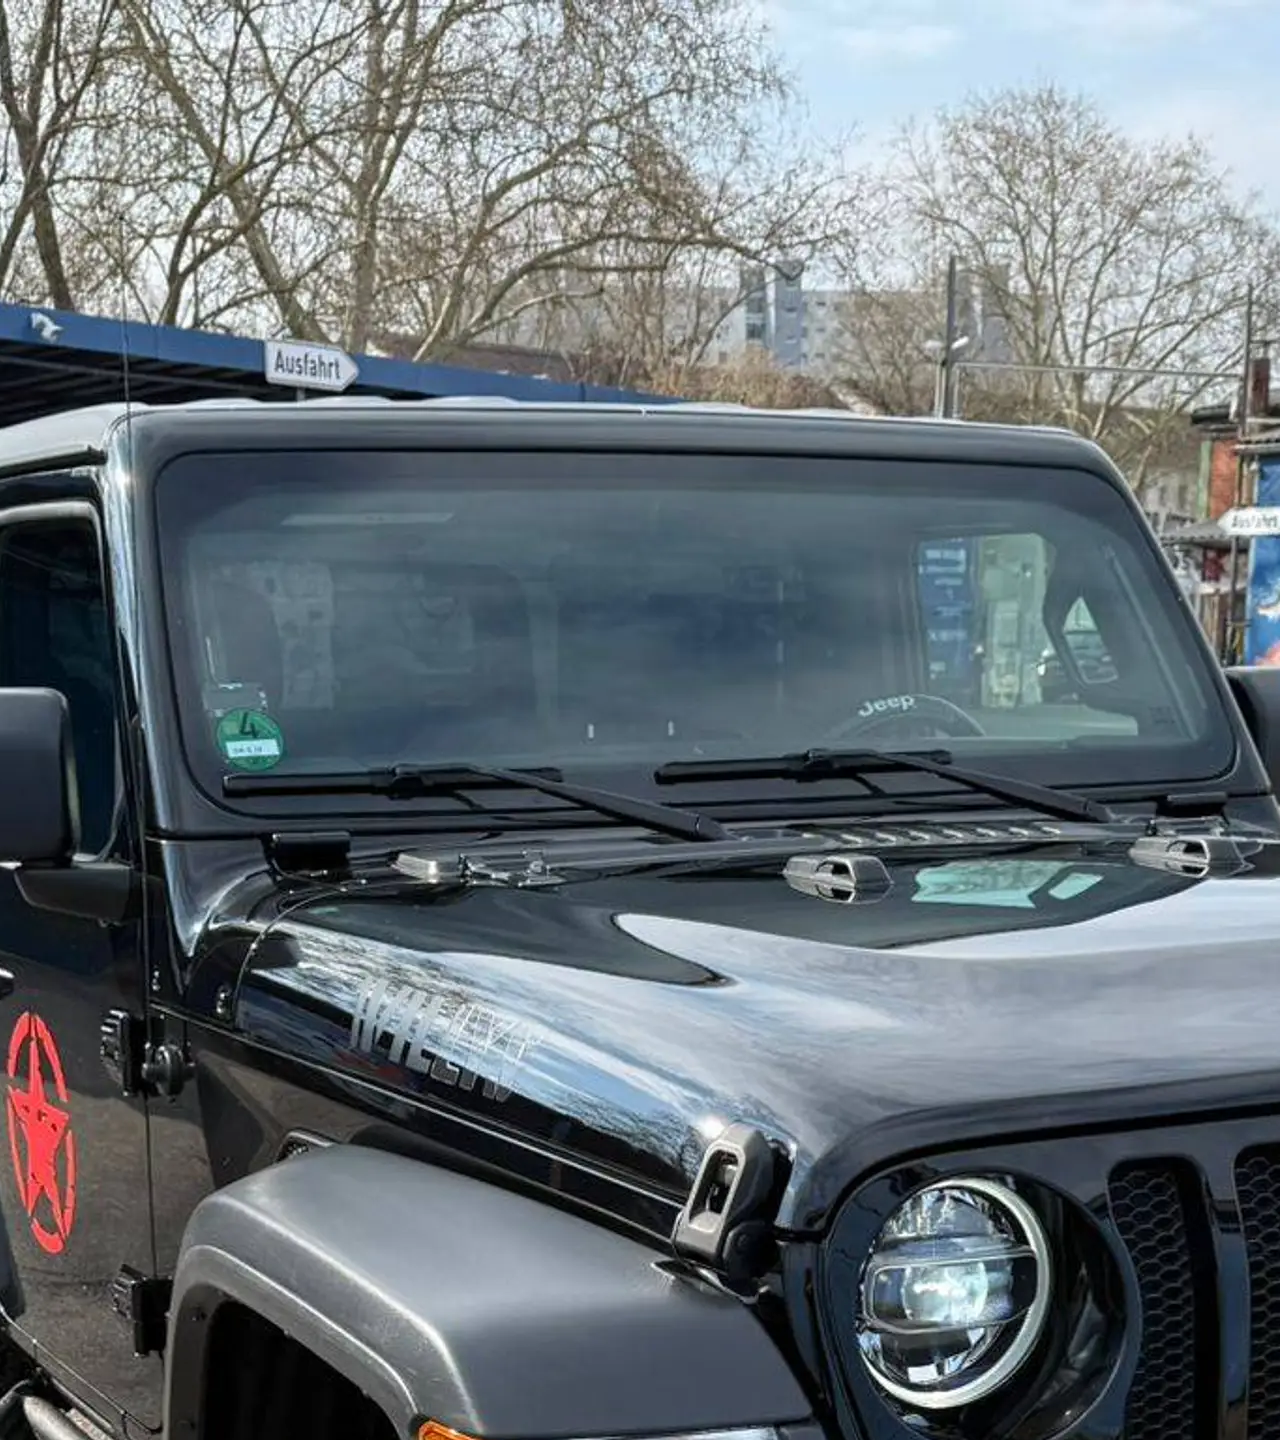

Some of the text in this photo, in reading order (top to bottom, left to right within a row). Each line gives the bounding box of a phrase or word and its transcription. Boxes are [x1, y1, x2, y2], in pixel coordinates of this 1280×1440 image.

[274, 349, 341, 380] Ausfahrt
[858, 694, 914, 717] Jeep
[239, 711, 260, 739] 4
